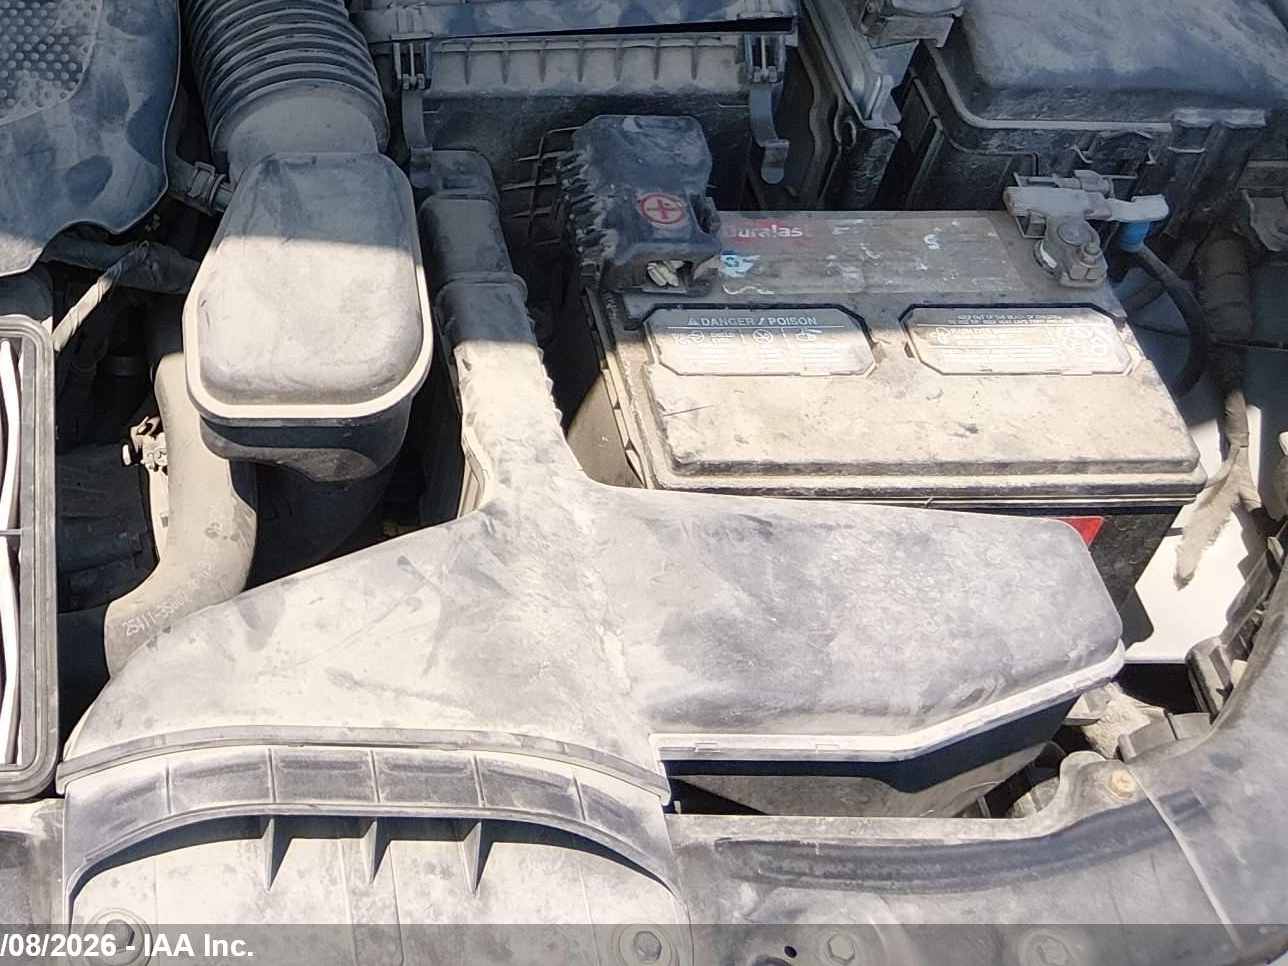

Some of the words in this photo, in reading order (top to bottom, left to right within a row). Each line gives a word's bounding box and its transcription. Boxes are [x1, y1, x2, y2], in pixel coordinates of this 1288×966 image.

[700, 317, 754, 326] DANGER
[758, 317, 765, 325] /
[768, 316, 818, 326] POISON
